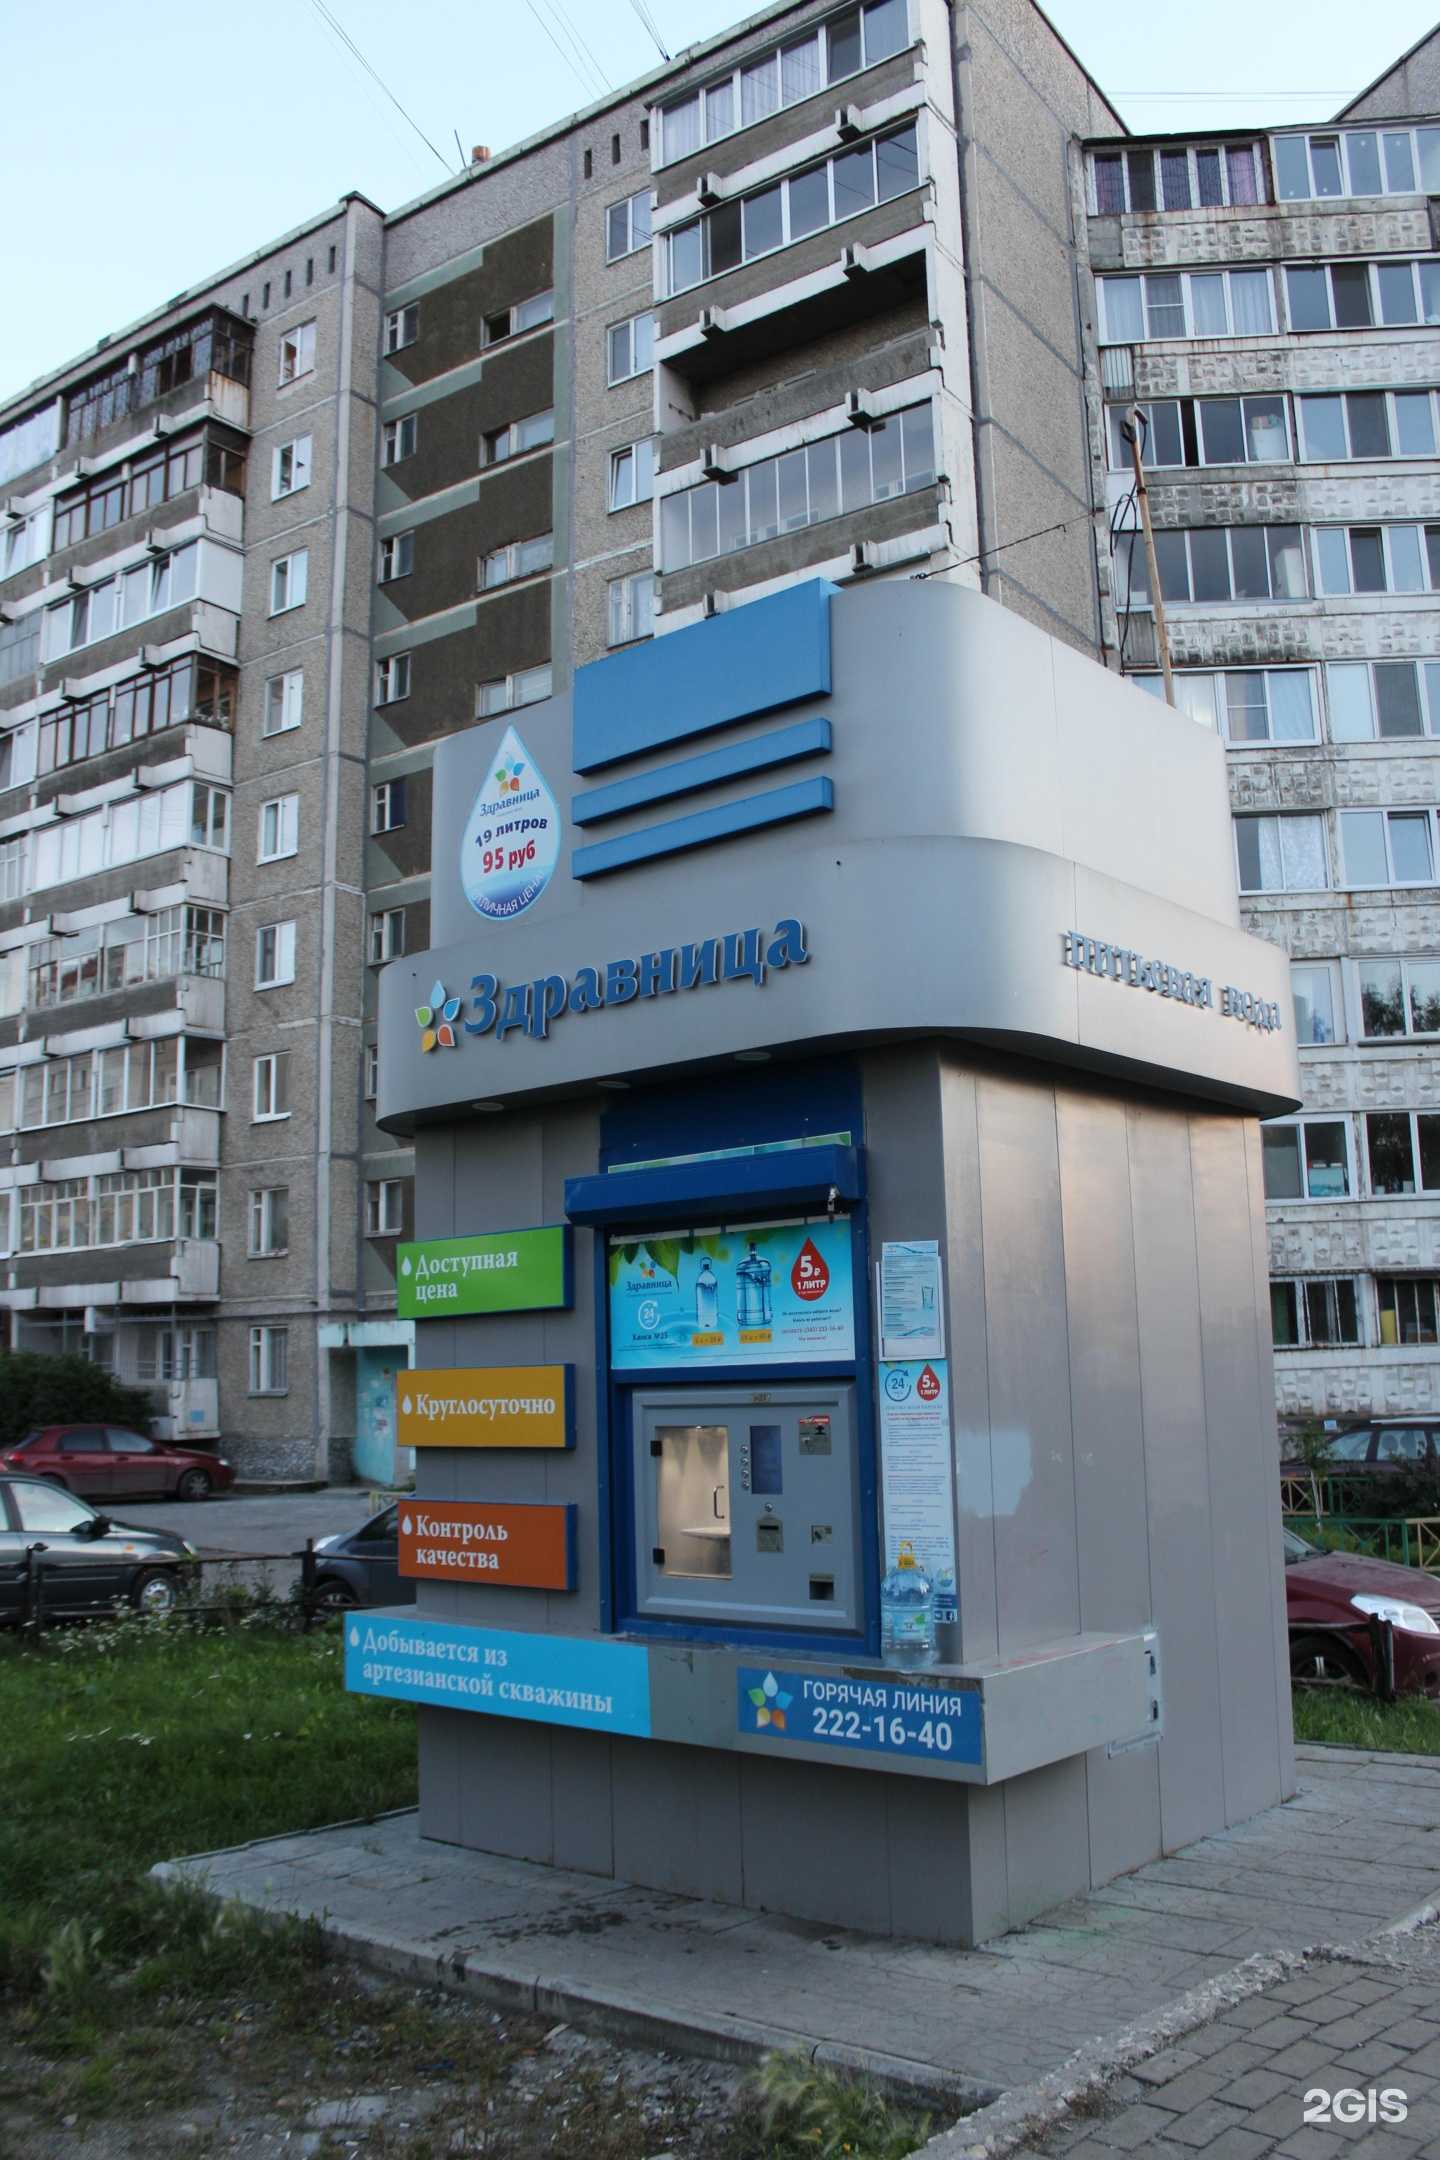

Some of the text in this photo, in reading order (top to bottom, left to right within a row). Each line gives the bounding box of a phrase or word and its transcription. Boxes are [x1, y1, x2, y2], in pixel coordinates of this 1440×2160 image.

[480, 789, 540, 816] Здравница
[475, 818, 548, 847] 19 литров
[483, 840, 536, 873] 95 руб
[464, 917, 812, 1040] Здравница
[416, 1250, 518, 1279] Доступная
[416, 1282, 458, 1303] цена
[891, 1377, 905, 1389] 24
[415, 1394, 556, 1420] Круглосуточно
[415, 1515, 508, 1544] Контроль
[415, 1548, 500, 1569] качества
[363, 1628, 508, 1667] Добывается из
[363, 1662, 613, 1714] артезианской скважины
[803, 1680, 962, 1717] ГОРЯЧАЯ ЛИНИЯ
[813, 1707, 953, 1751] 222-16-40
